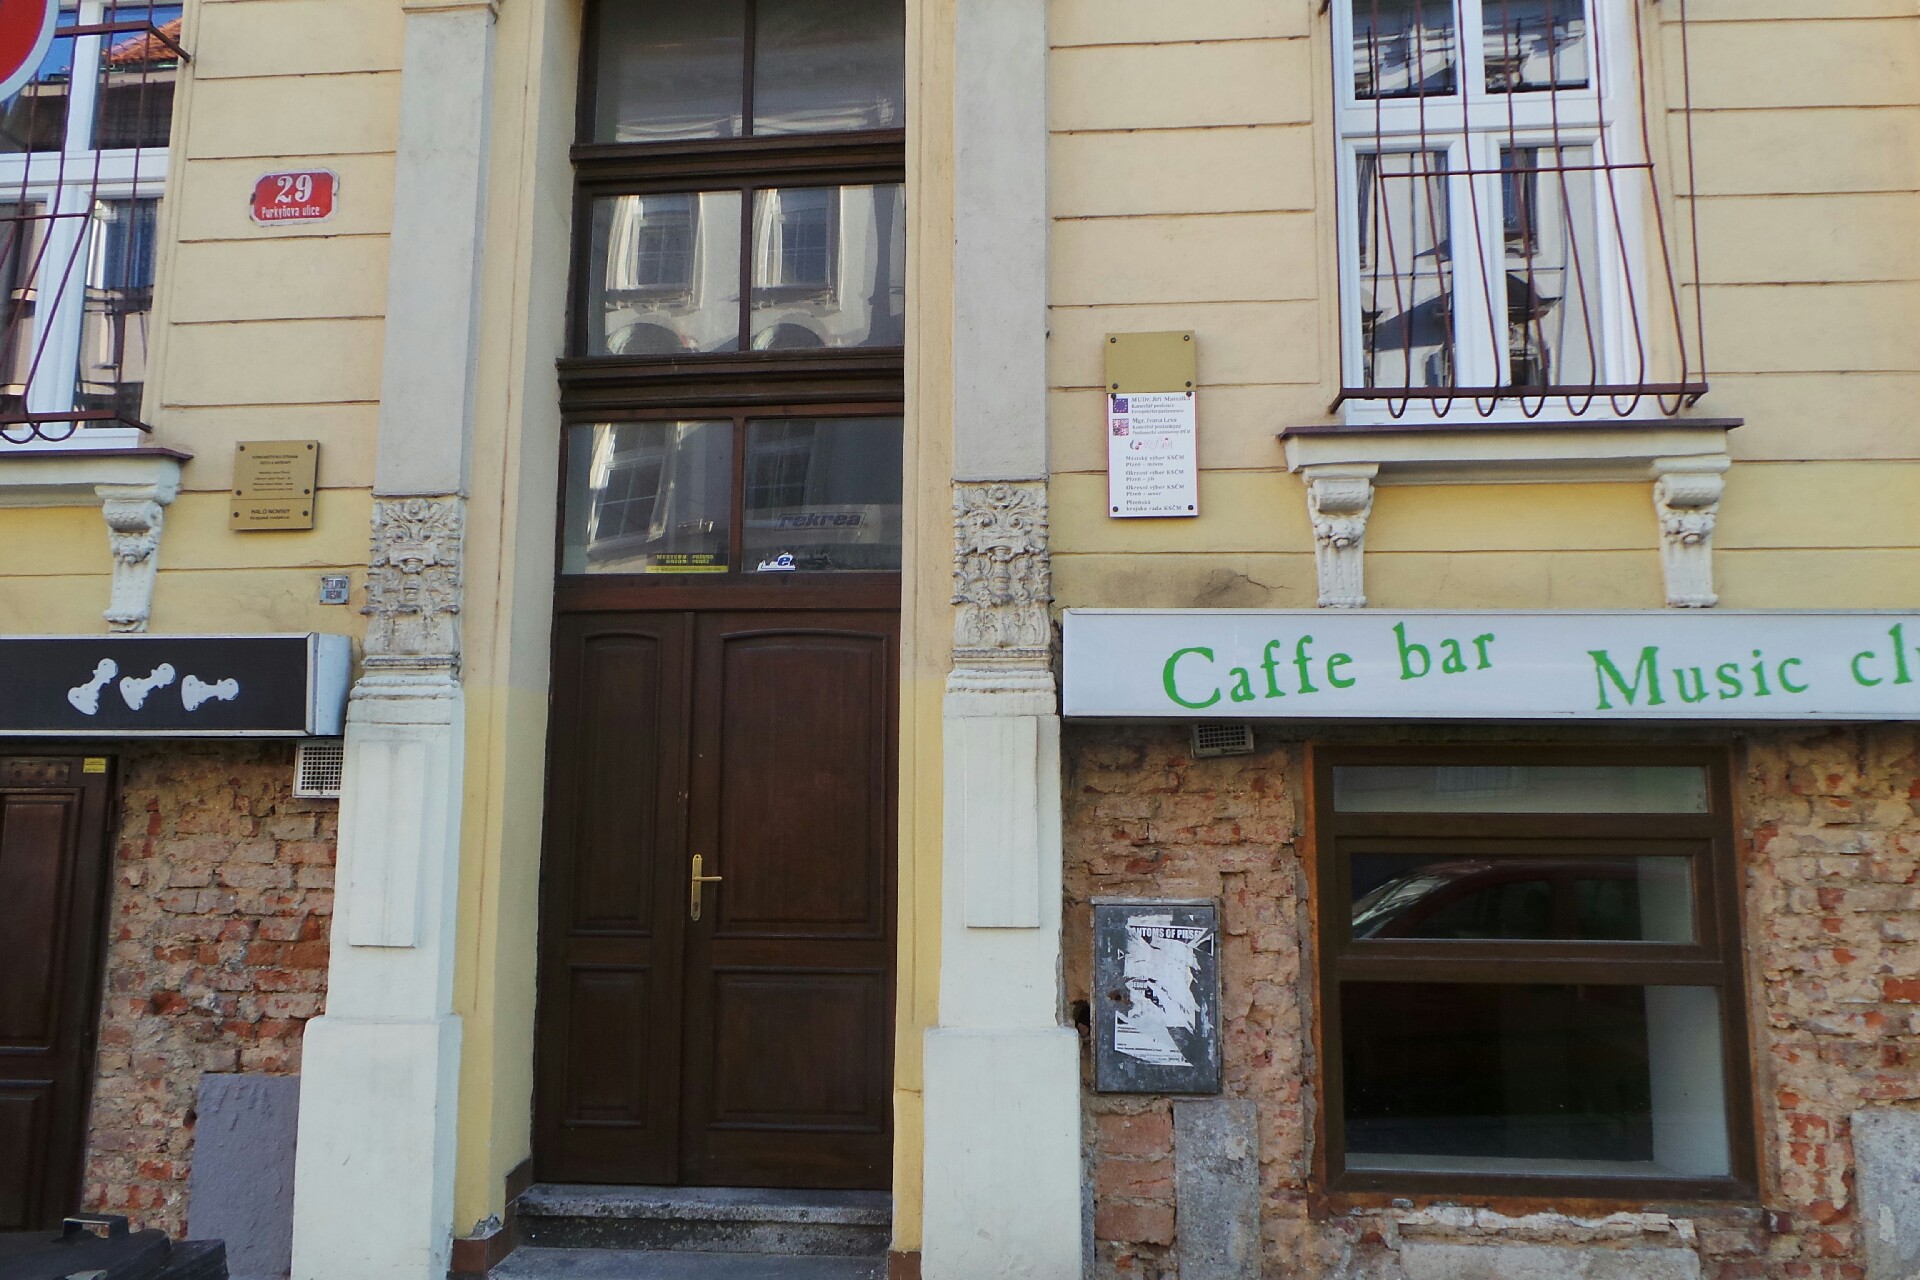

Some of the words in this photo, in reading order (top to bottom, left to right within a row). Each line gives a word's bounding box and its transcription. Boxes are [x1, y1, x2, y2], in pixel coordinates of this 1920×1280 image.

[275, 174, 313, 203] 29
[261, 205, 299, 218] Purkyňova
[302, 205, 320, 216] ulice
[779, 513, 861, 527] rekrea
[1163, 635, 1356, 709] Caffe
[1392, 622, 1495, 680] bar
[1586, 646, 1809, 710] Music
[1850, 622, 1920, 687] cl
[1165, 928, 1176, 939] OF
